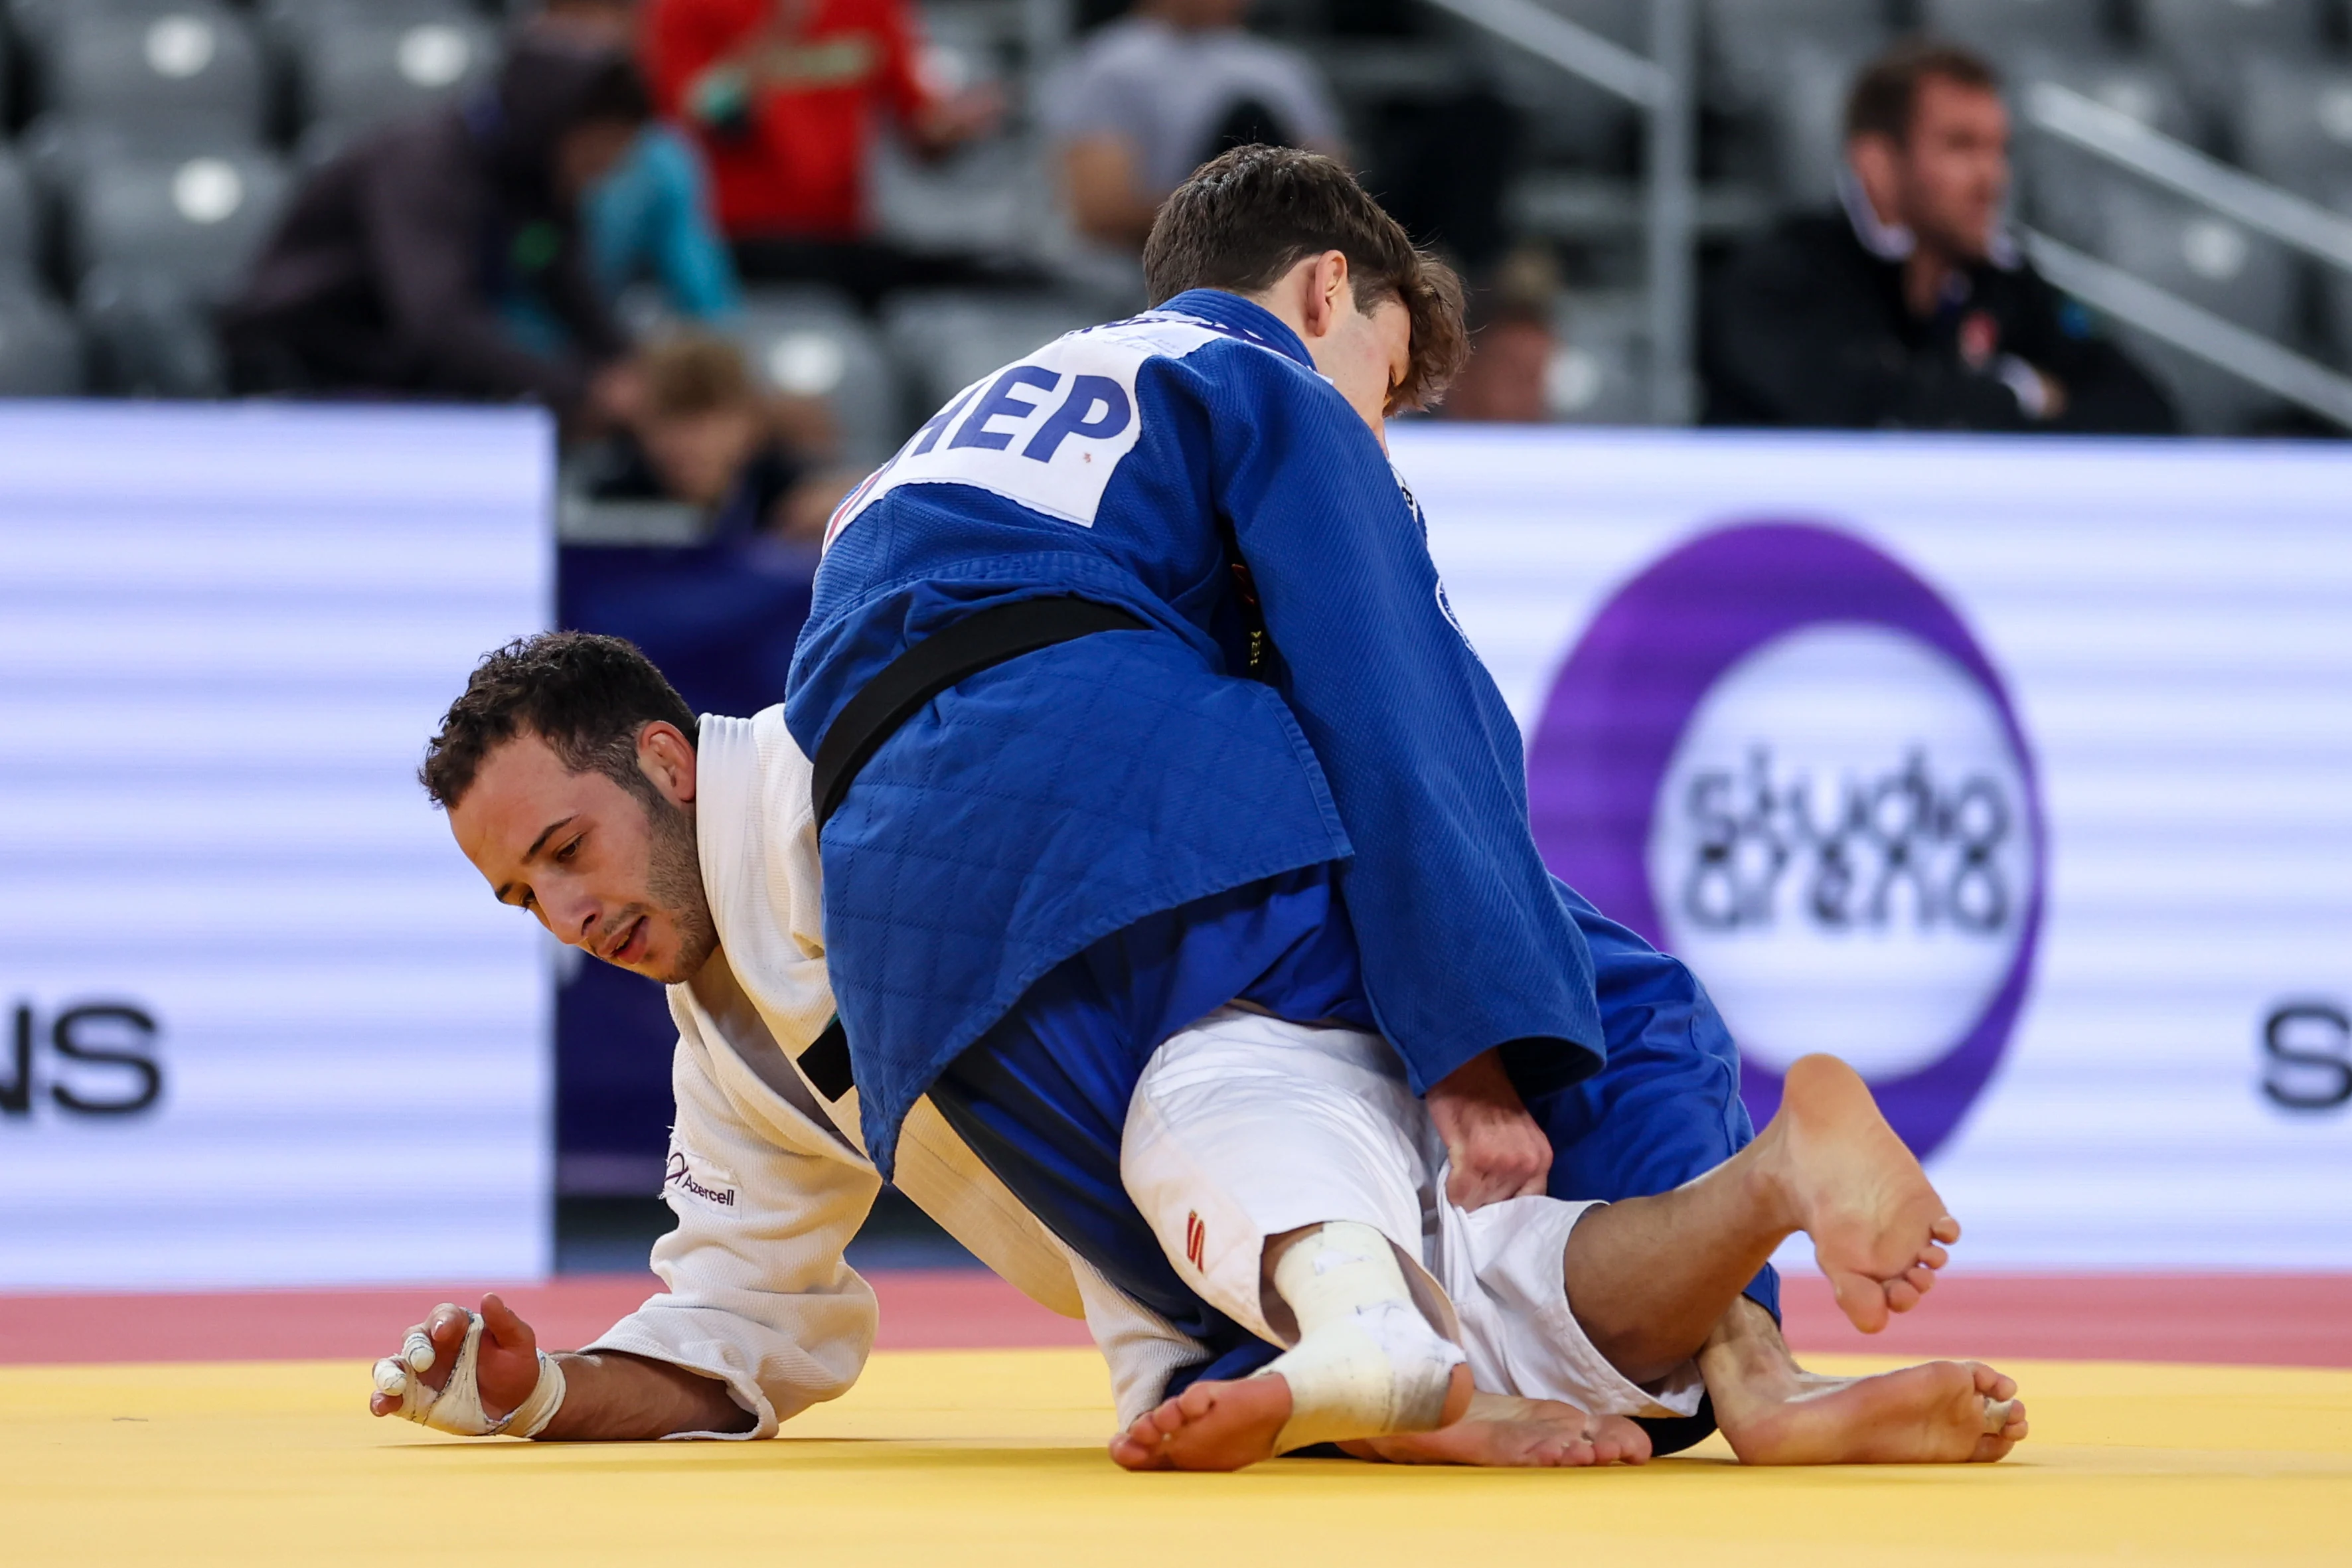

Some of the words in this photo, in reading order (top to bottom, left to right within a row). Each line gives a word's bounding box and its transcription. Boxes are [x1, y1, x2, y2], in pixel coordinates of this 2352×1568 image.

[1684, 745, 2011, 855] studio
[1682, 840, 2011, 932] arena
[682, 1174, 735, 1207] Azercell
